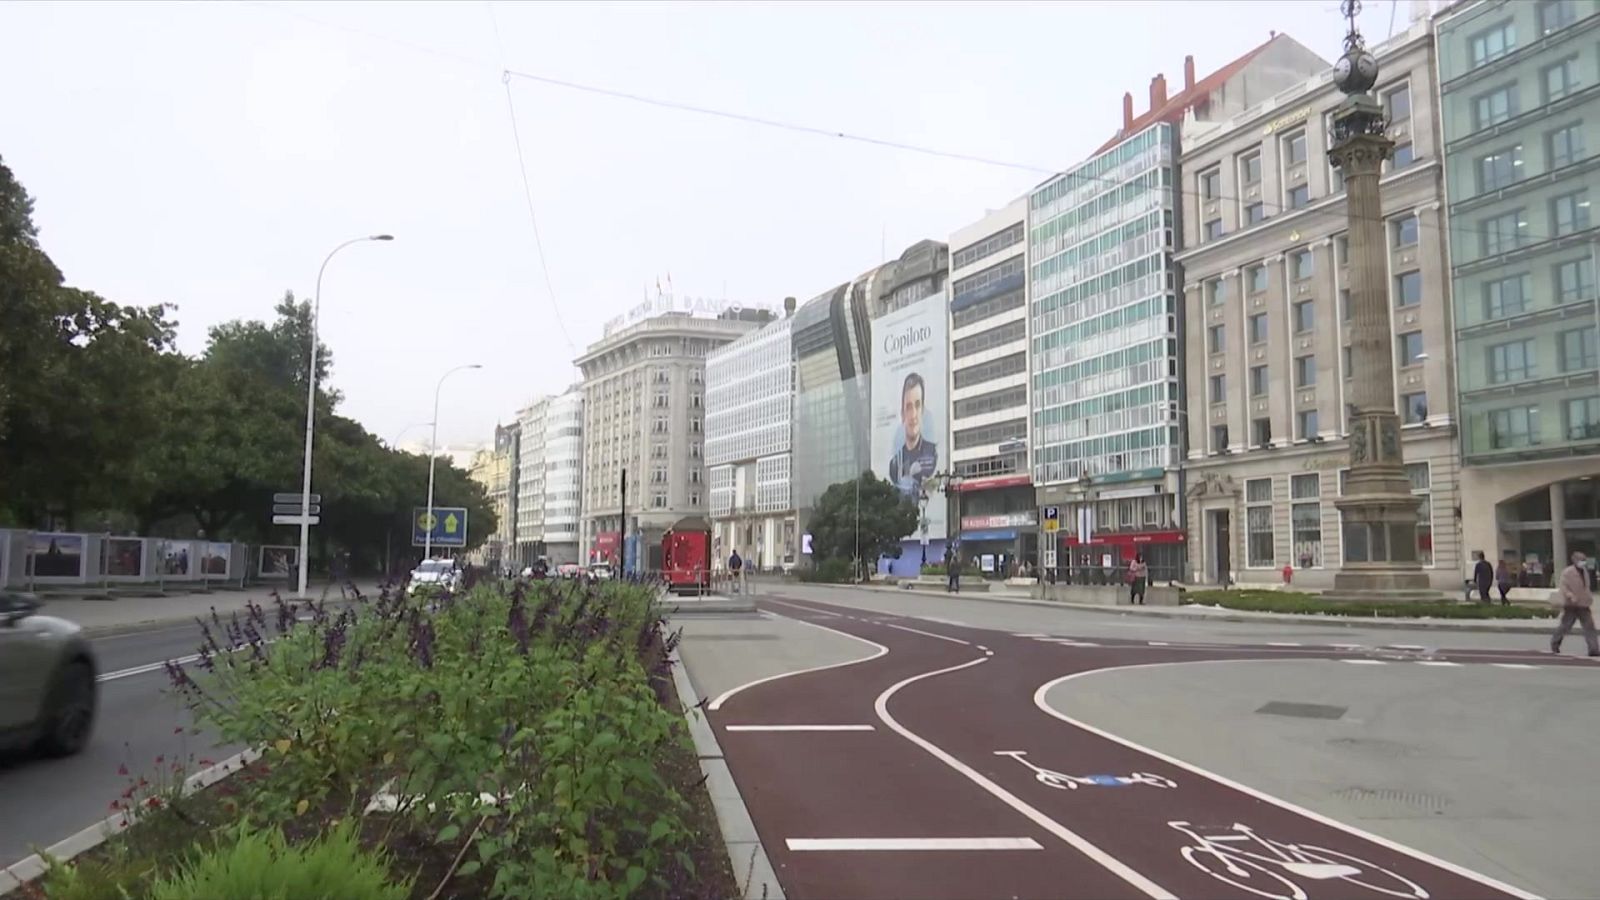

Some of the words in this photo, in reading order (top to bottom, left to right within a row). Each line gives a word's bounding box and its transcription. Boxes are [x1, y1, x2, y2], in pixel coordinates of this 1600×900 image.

[684, 295, 743, 313] BANCO
[884, 326, 931, 354] Copiloto
[1047, 508, 1055, 518] P
